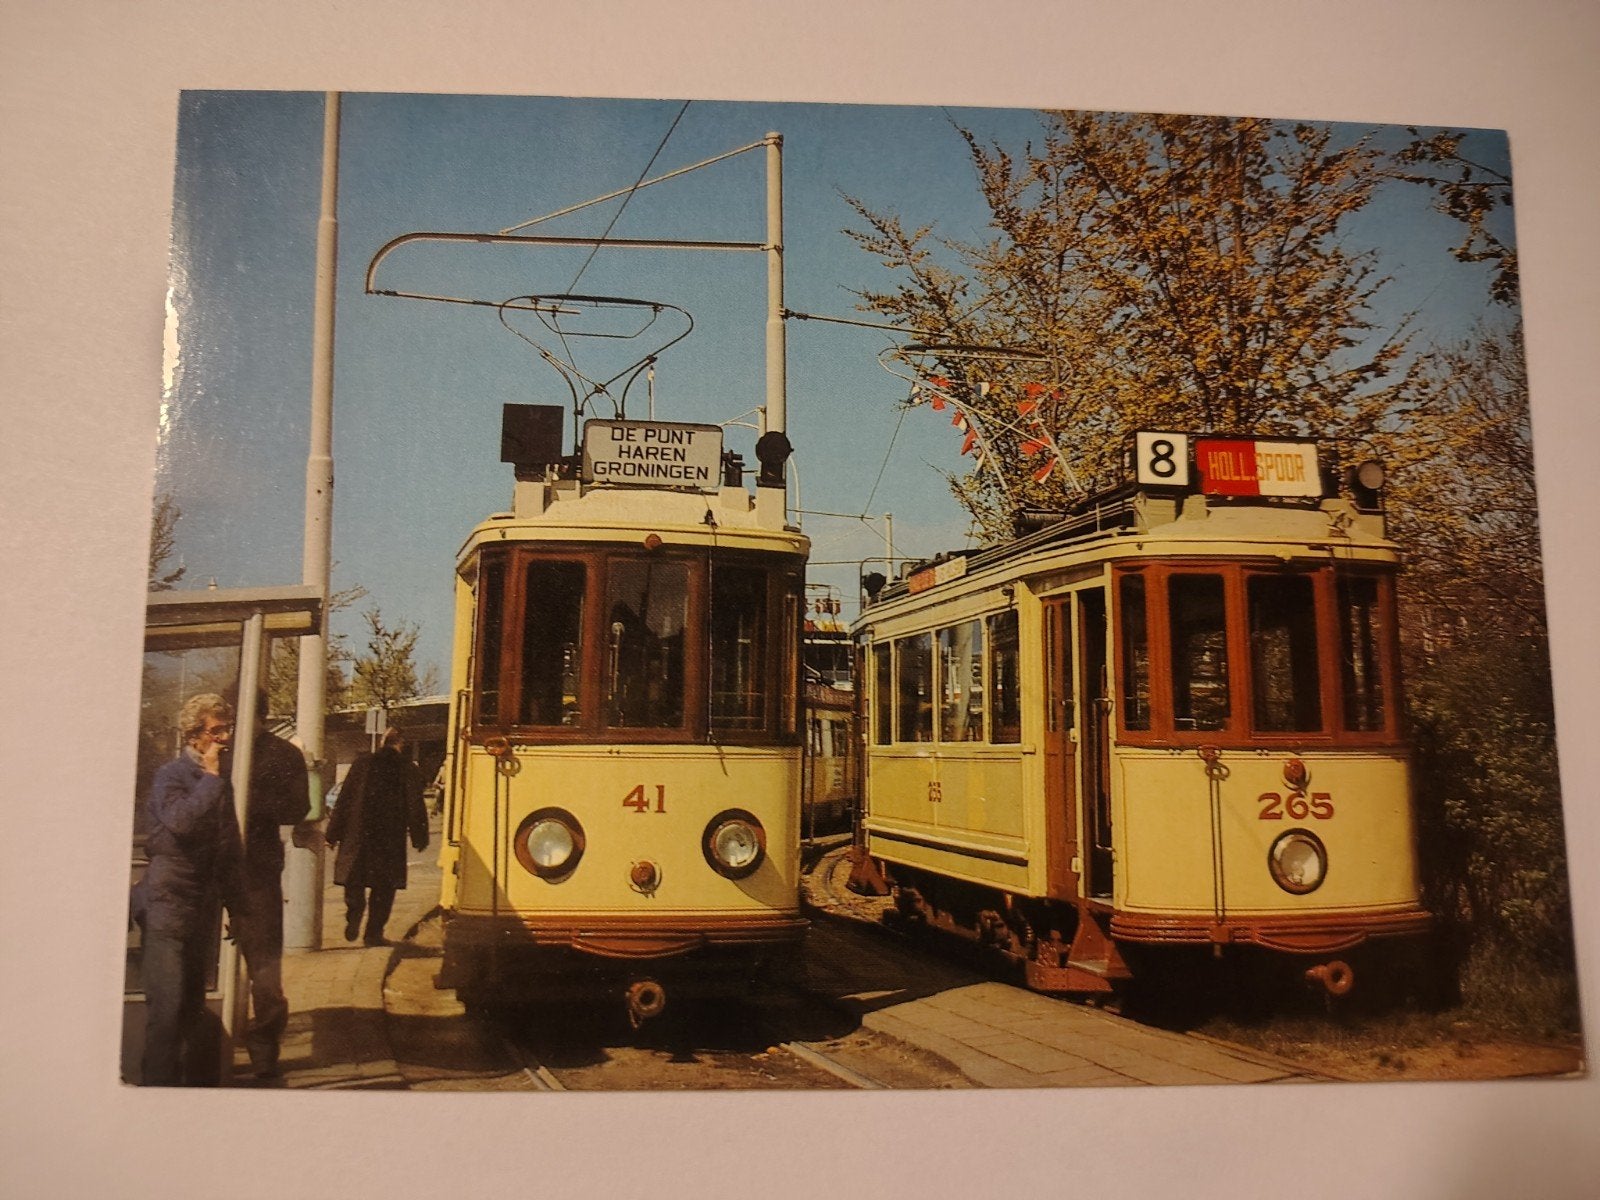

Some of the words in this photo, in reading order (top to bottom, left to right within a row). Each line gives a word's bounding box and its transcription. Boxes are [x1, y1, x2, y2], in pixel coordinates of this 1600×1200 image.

[611, 427, 637, 442] DE
[644, 428, 696, 445] PUNT
[618, 445, 686, 462] HAREN
[1150, 440, 1176, 478] 8
[594, 461, 709, 480] GRONINGEN
[622, 784, 666, 814] 41
[1257, 792, 1334, 820] 265
